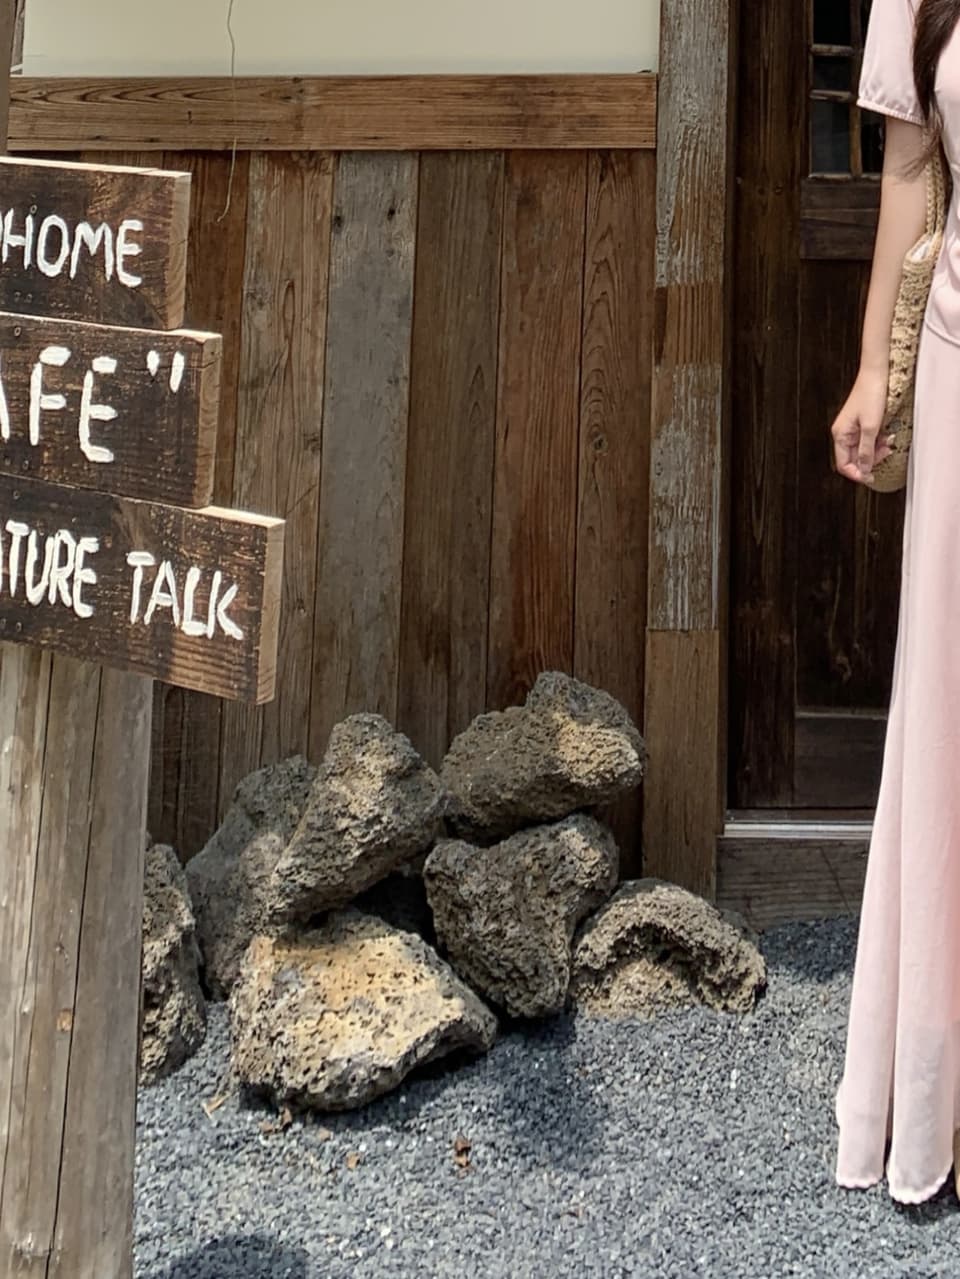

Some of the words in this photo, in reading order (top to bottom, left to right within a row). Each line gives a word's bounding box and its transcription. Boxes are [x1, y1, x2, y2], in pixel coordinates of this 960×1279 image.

[0, 207, 144, 288] HOME
[0, 519, 100, 619] TURE
[126, 551, 244, 641] TALK
